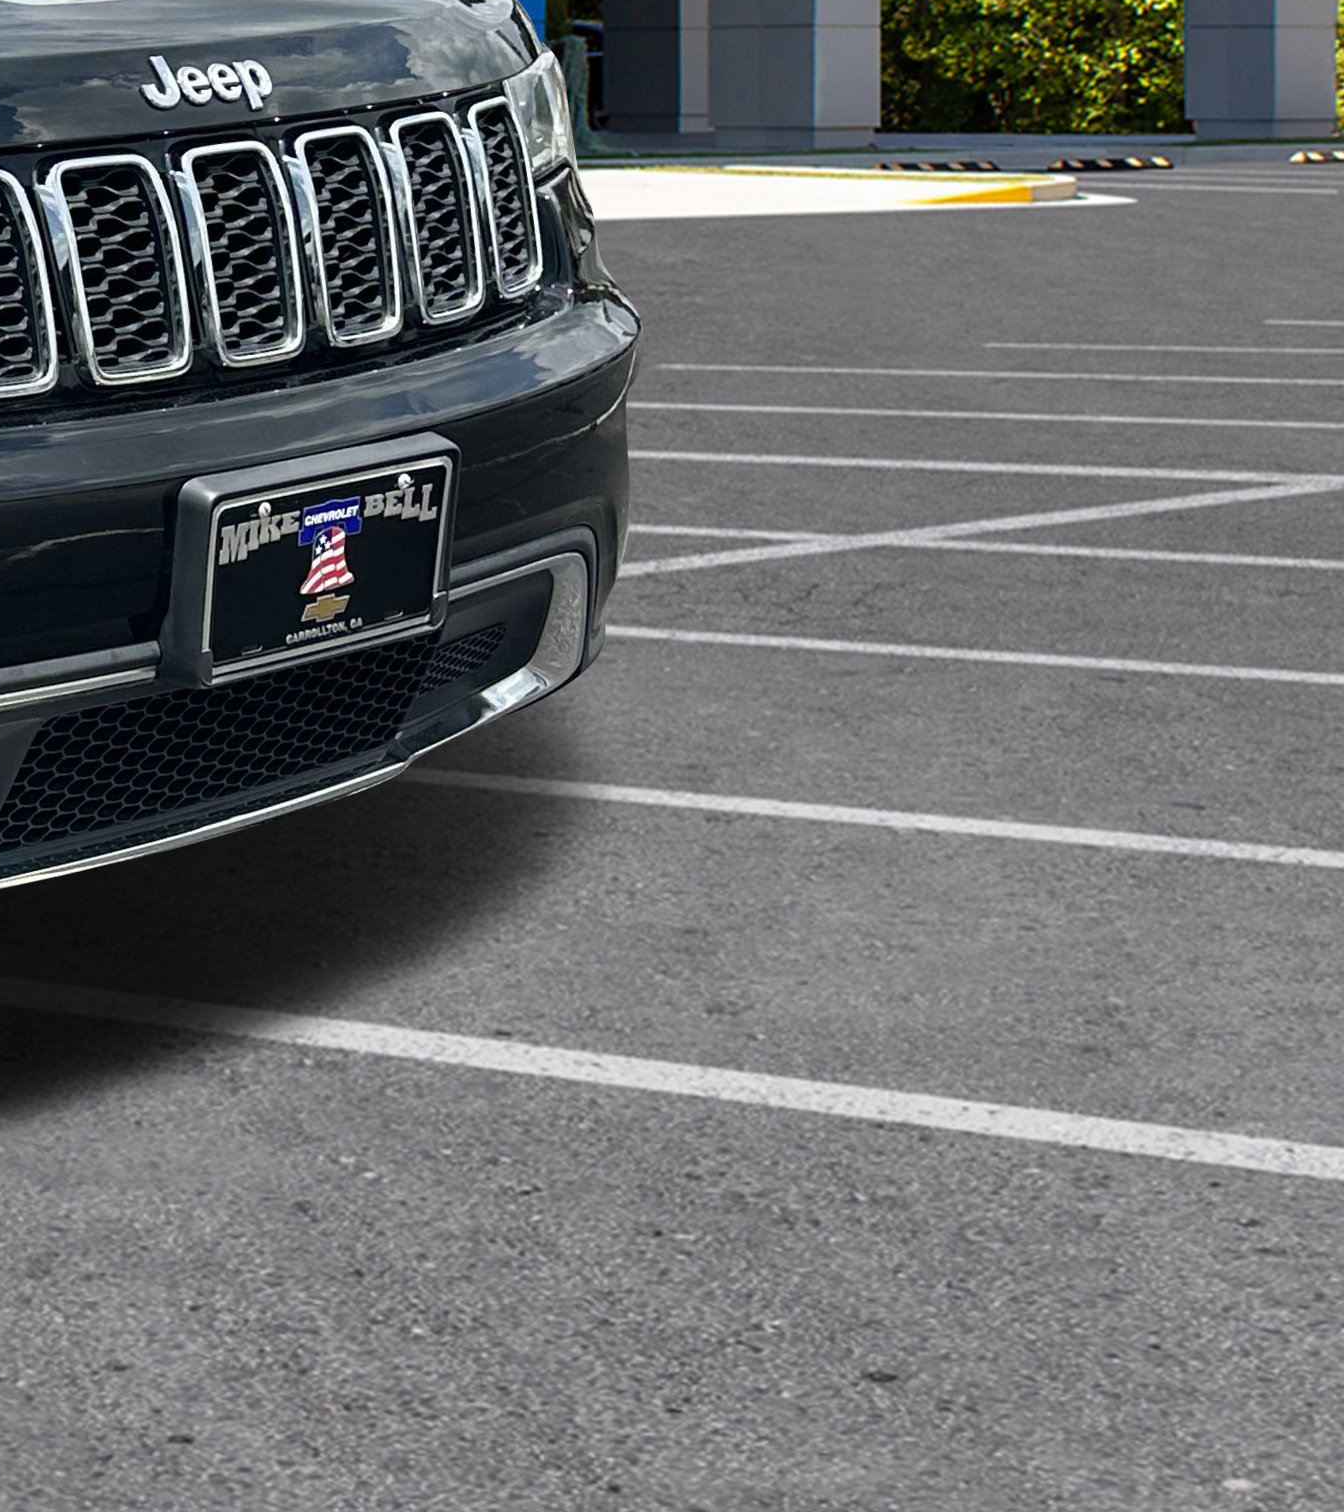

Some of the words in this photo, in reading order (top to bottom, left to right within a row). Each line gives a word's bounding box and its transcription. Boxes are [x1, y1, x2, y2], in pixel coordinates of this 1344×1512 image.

[141, 55, 273, 110] Jeep
[218, 510, 301, 565] MIKE
[364, 483, 438, 522] BELL
[304, 504, 359, 527] CHEVROLET
[350, 617, 364, 630] GA
